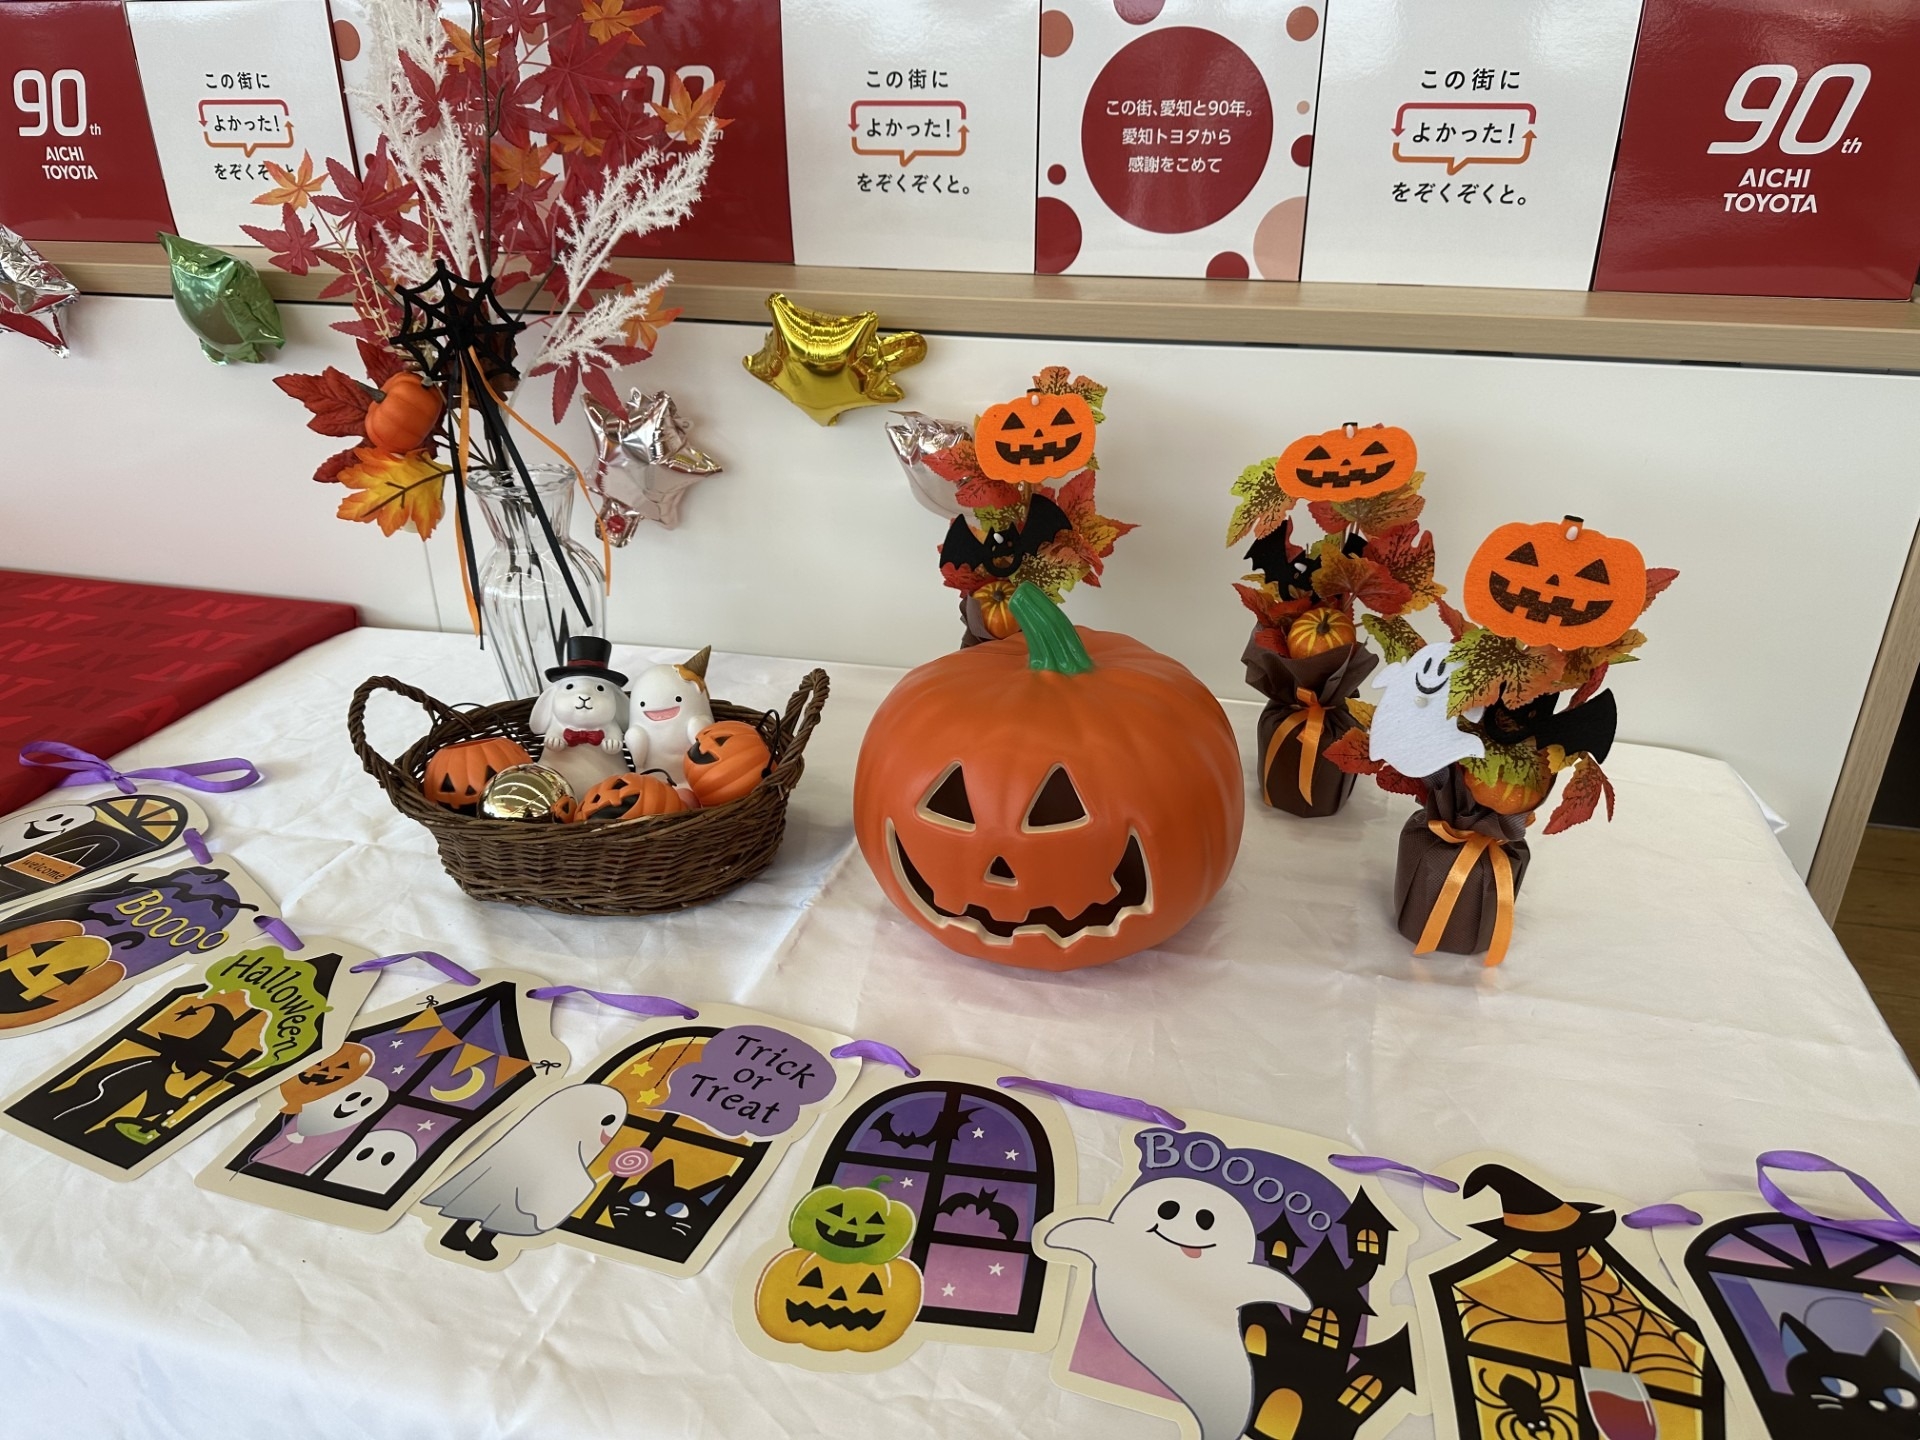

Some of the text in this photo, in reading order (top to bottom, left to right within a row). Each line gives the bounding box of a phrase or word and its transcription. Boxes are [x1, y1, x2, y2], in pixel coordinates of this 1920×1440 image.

[205, 71, 270, 90] この街に
[866, 68, 949, 90] この街に
[1421, 68, 1520, 91] この街に
[1106, 99, 1253, 118] この街、愛知と90年。
[214, 114, 280, 132] よかった!
[866, 117, 951, 138] よかった!
[1412, 121, 1516, 144] よかった!
[1121, 127, 1232, 146] 愛知トヨタから
[46, 146, 85, 161] AICHI
[42, 164, 98, 180] TOYOTA
[1128, 156, 1223, 173] 感謝をこめて
[857, 172, 970, 195] をぞくぞくと。
[1738, 167, 1812, 188] AICHI
[1392, 181, 1527, 206] をぞくぞくと。
[1723, 192, 1818, 213] TOYOTA
[22, 859, 65, 880] welcome
[219, 954, 314, 1061] Halloween
[734, 1034, 816, 1089] Trick
[732, 1067, 773, 1090] or
[689, 1073, 780, 1124] Treat
